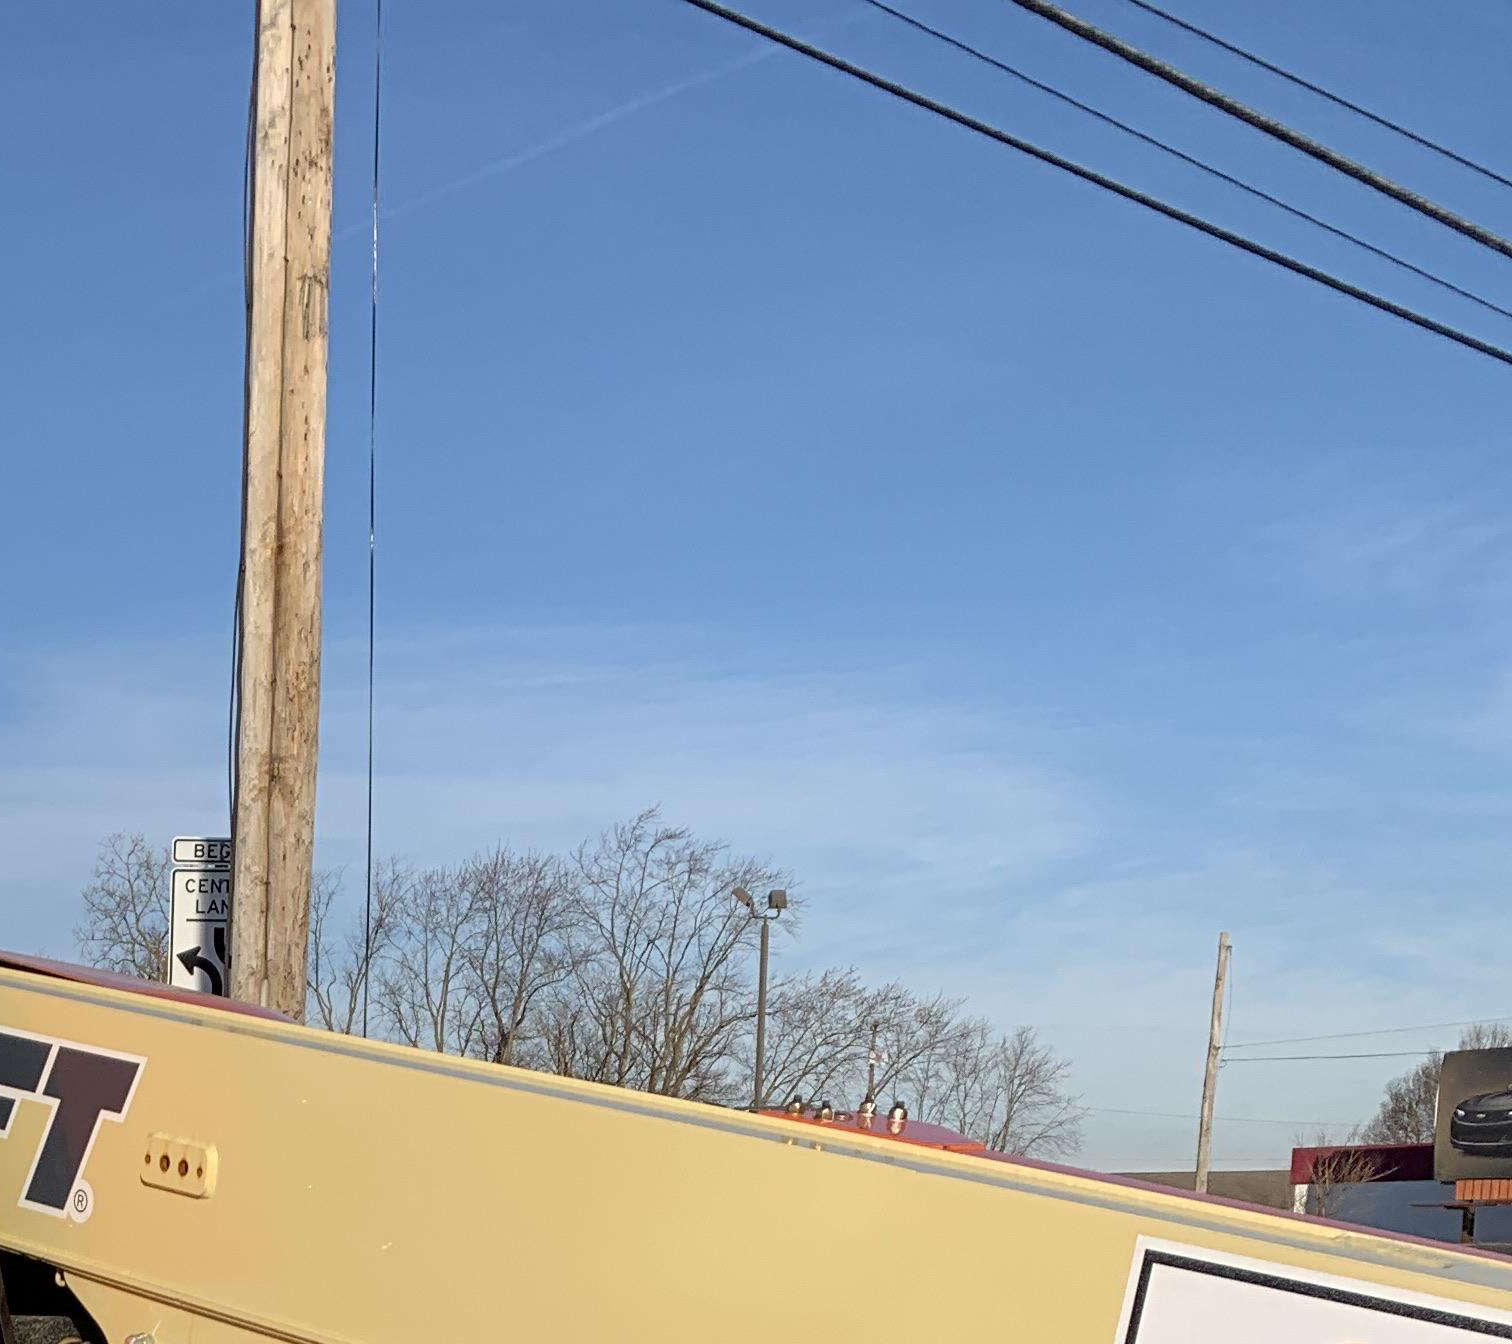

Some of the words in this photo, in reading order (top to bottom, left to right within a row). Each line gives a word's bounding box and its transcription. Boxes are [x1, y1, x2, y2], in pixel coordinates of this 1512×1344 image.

[194, 843, 231, 859] BEG
[185, 878, 230, 894] CENT
[195, 899, 229, 915] LAN
